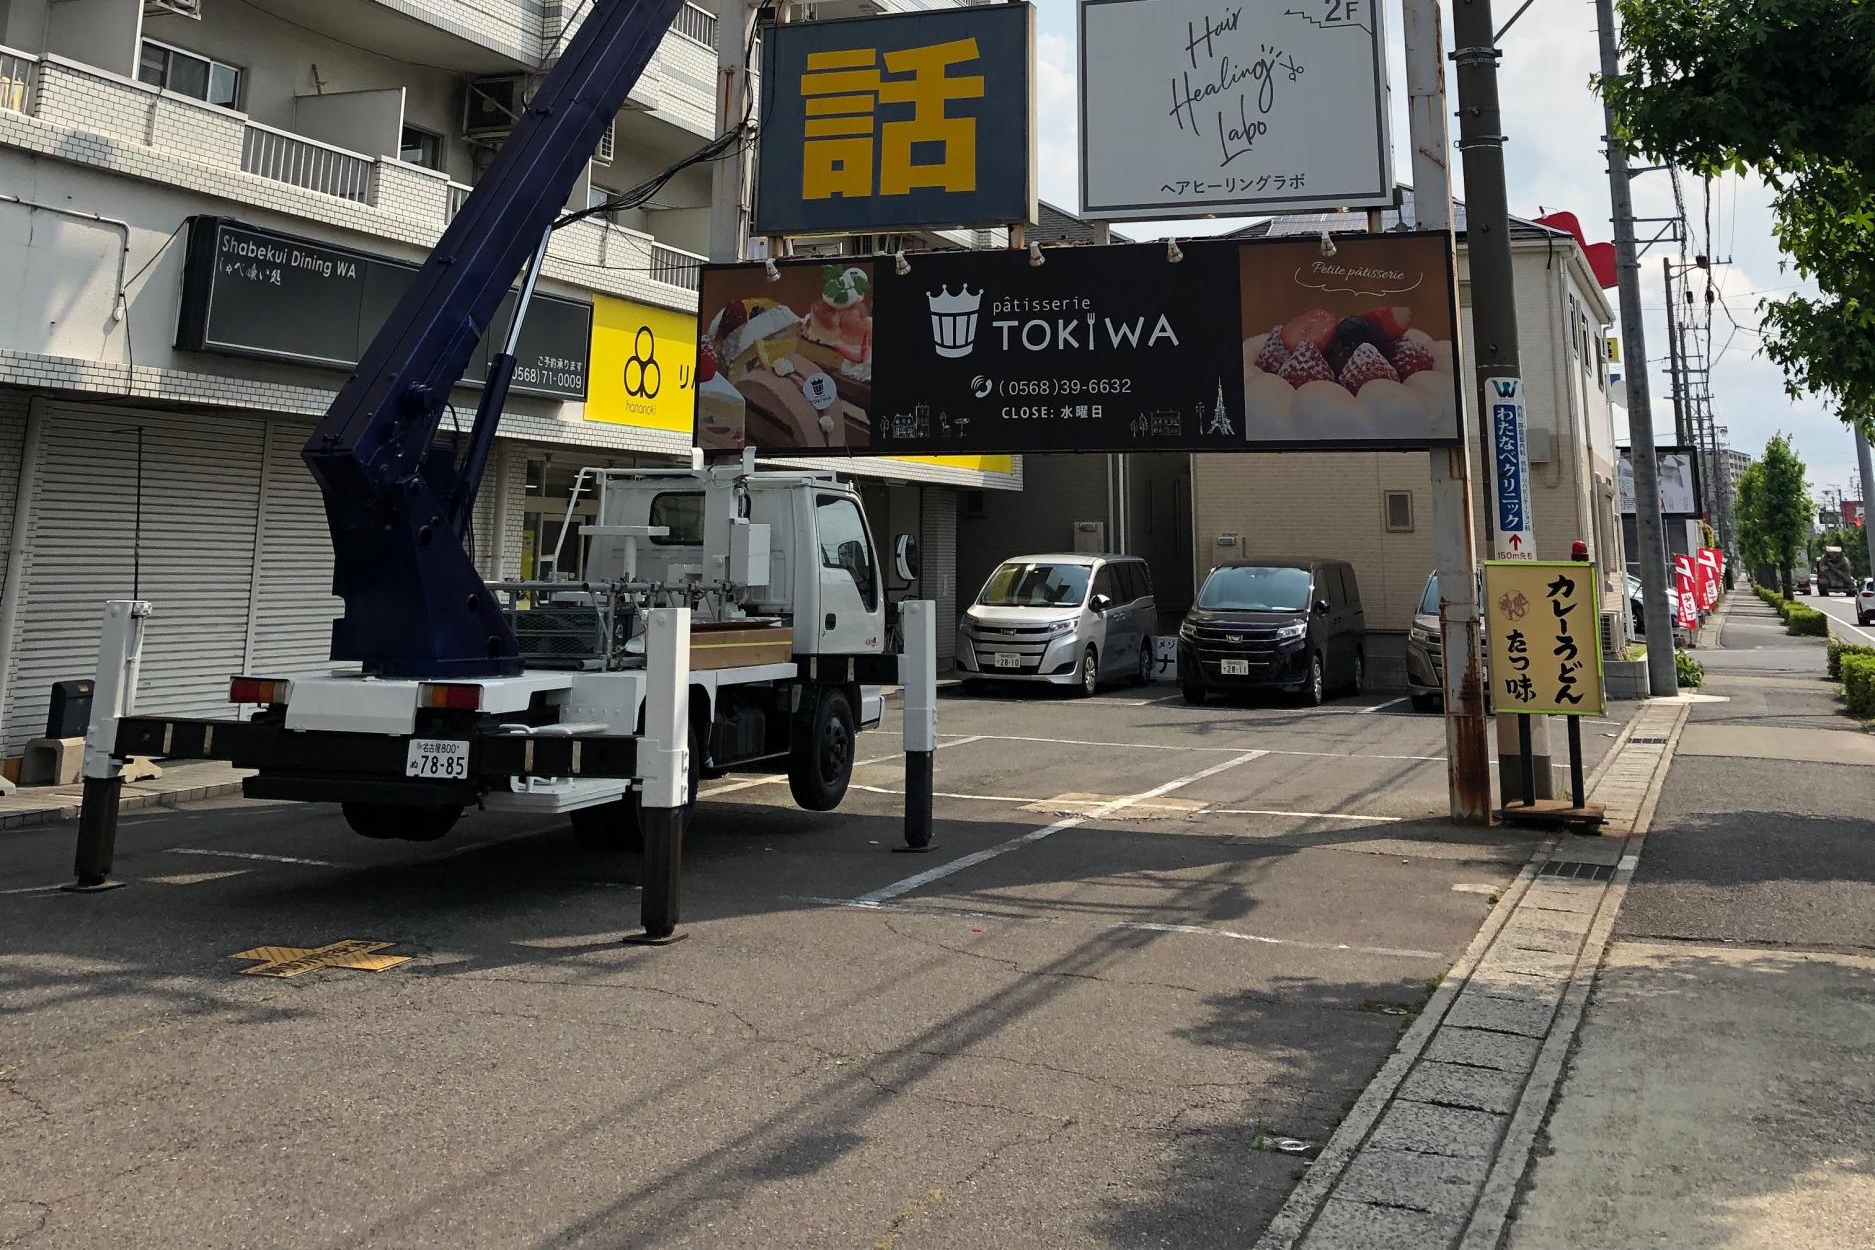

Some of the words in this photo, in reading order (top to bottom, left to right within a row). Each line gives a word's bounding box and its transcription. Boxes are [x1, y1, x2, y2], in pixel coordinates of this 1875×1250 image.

[1185, 6, 1244, 69] Hair
[1169, 55, 1276, 137] Healing
[1217, 94, 1268, 167] Labo
[1160, 172, 1306, 195] ヘアヒーリングラボ
[222, 235, 287, 265] Shabekui
[290, 251, 333, 278] Dining
[336, 261, 357, 279] WA
[1311, 261, 1346, 274] Petite
[992, 296, 1091, 316] pâtisserie
[992, 312, 1180, 351] TOKIWA
[537, 355, 583, 372] ご予約承ります
[999, 378, 1132, 396] (0568)39-6632
[1060, 405, 1103, 419] 水曜日
[1497, 407, 1519, 529] わたなべクリニック
[1547, 575, 1585, 705] カレーうどん
[1505, 629, 1537, 704] たつ味
[420, 755, 465, 776] 78-85
